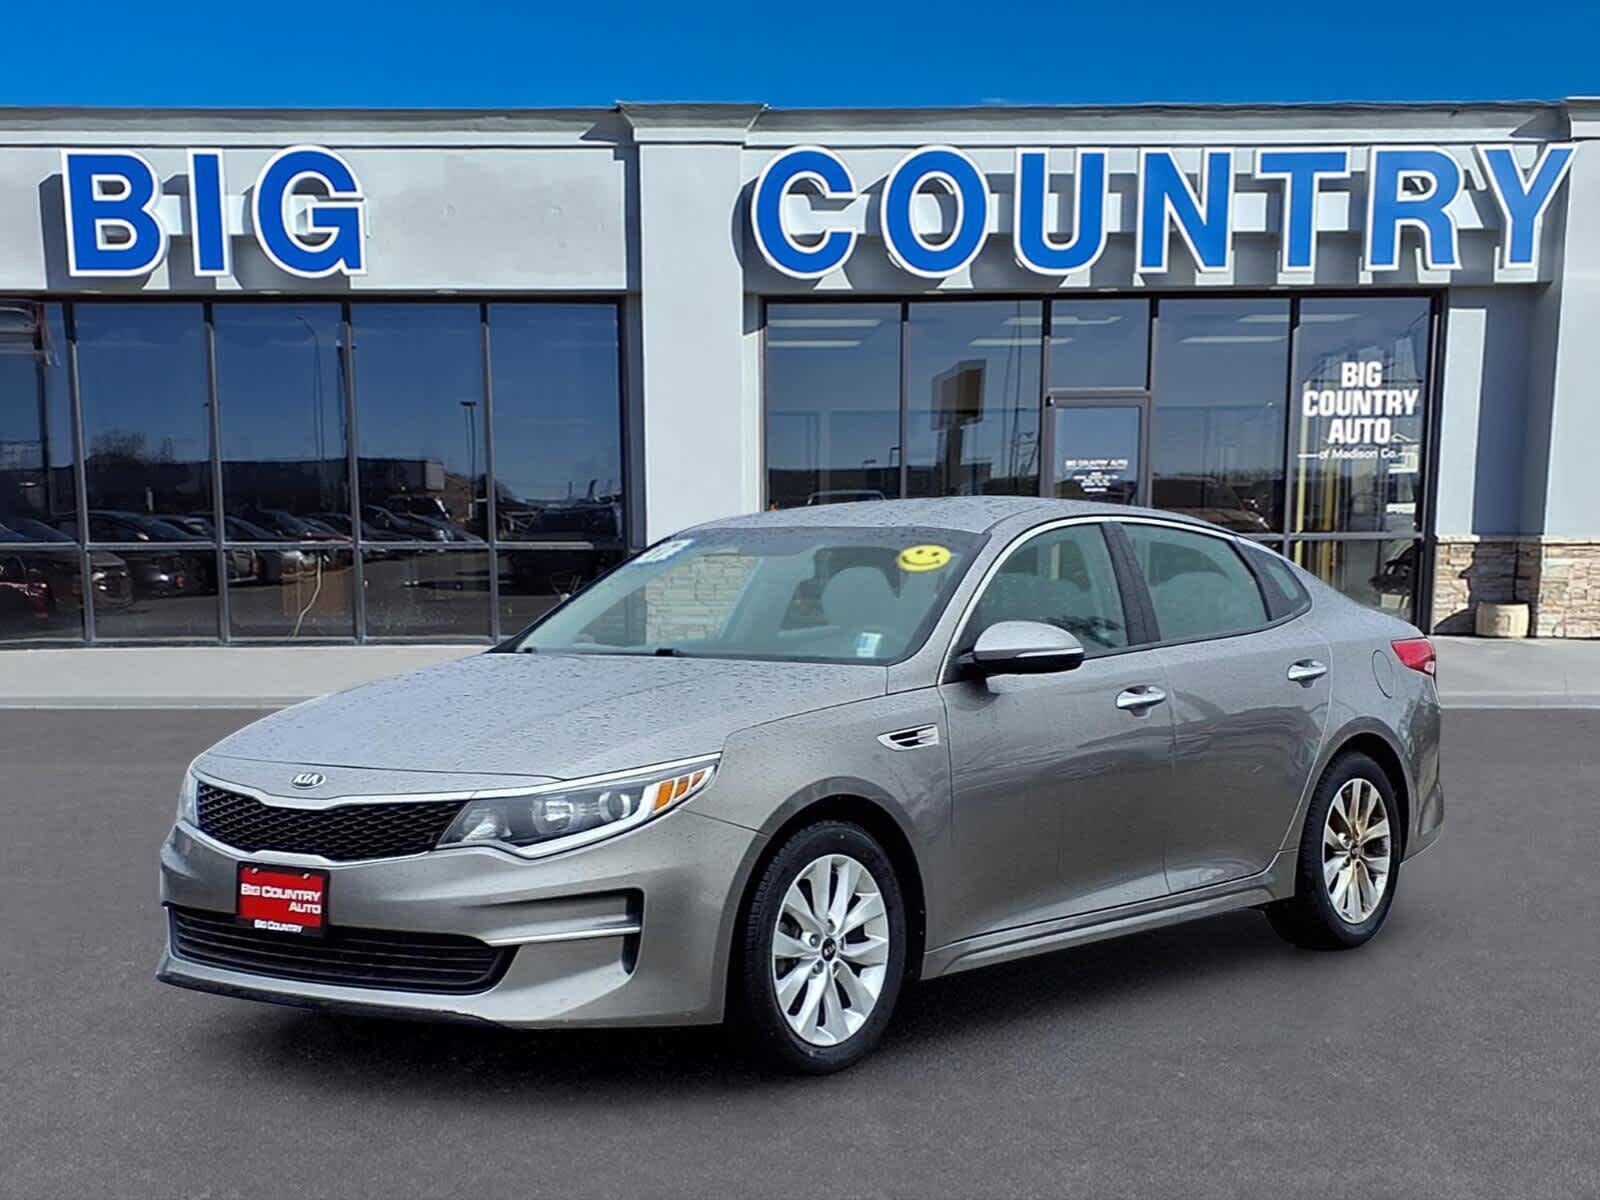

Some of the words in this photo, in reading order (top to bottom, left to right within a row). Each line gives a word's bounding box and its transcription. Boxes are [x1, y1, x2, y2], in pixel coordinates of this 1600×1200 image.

[61, 145, 368, 278] BIG
[751, 143, 1576, 279] COUNTRY
[1341, 361, 1383, 388] BIG
[1302, 389, 1419, 417] COUNTRY
[1327, 418, 1391, 445] AUTO
[1331, 447, 1379, 460] Madison
[293, 773, 319, 785] KIA
[262, 885, 321, 902] COUNTRY
[288, 901, 321, 914] AUTO
